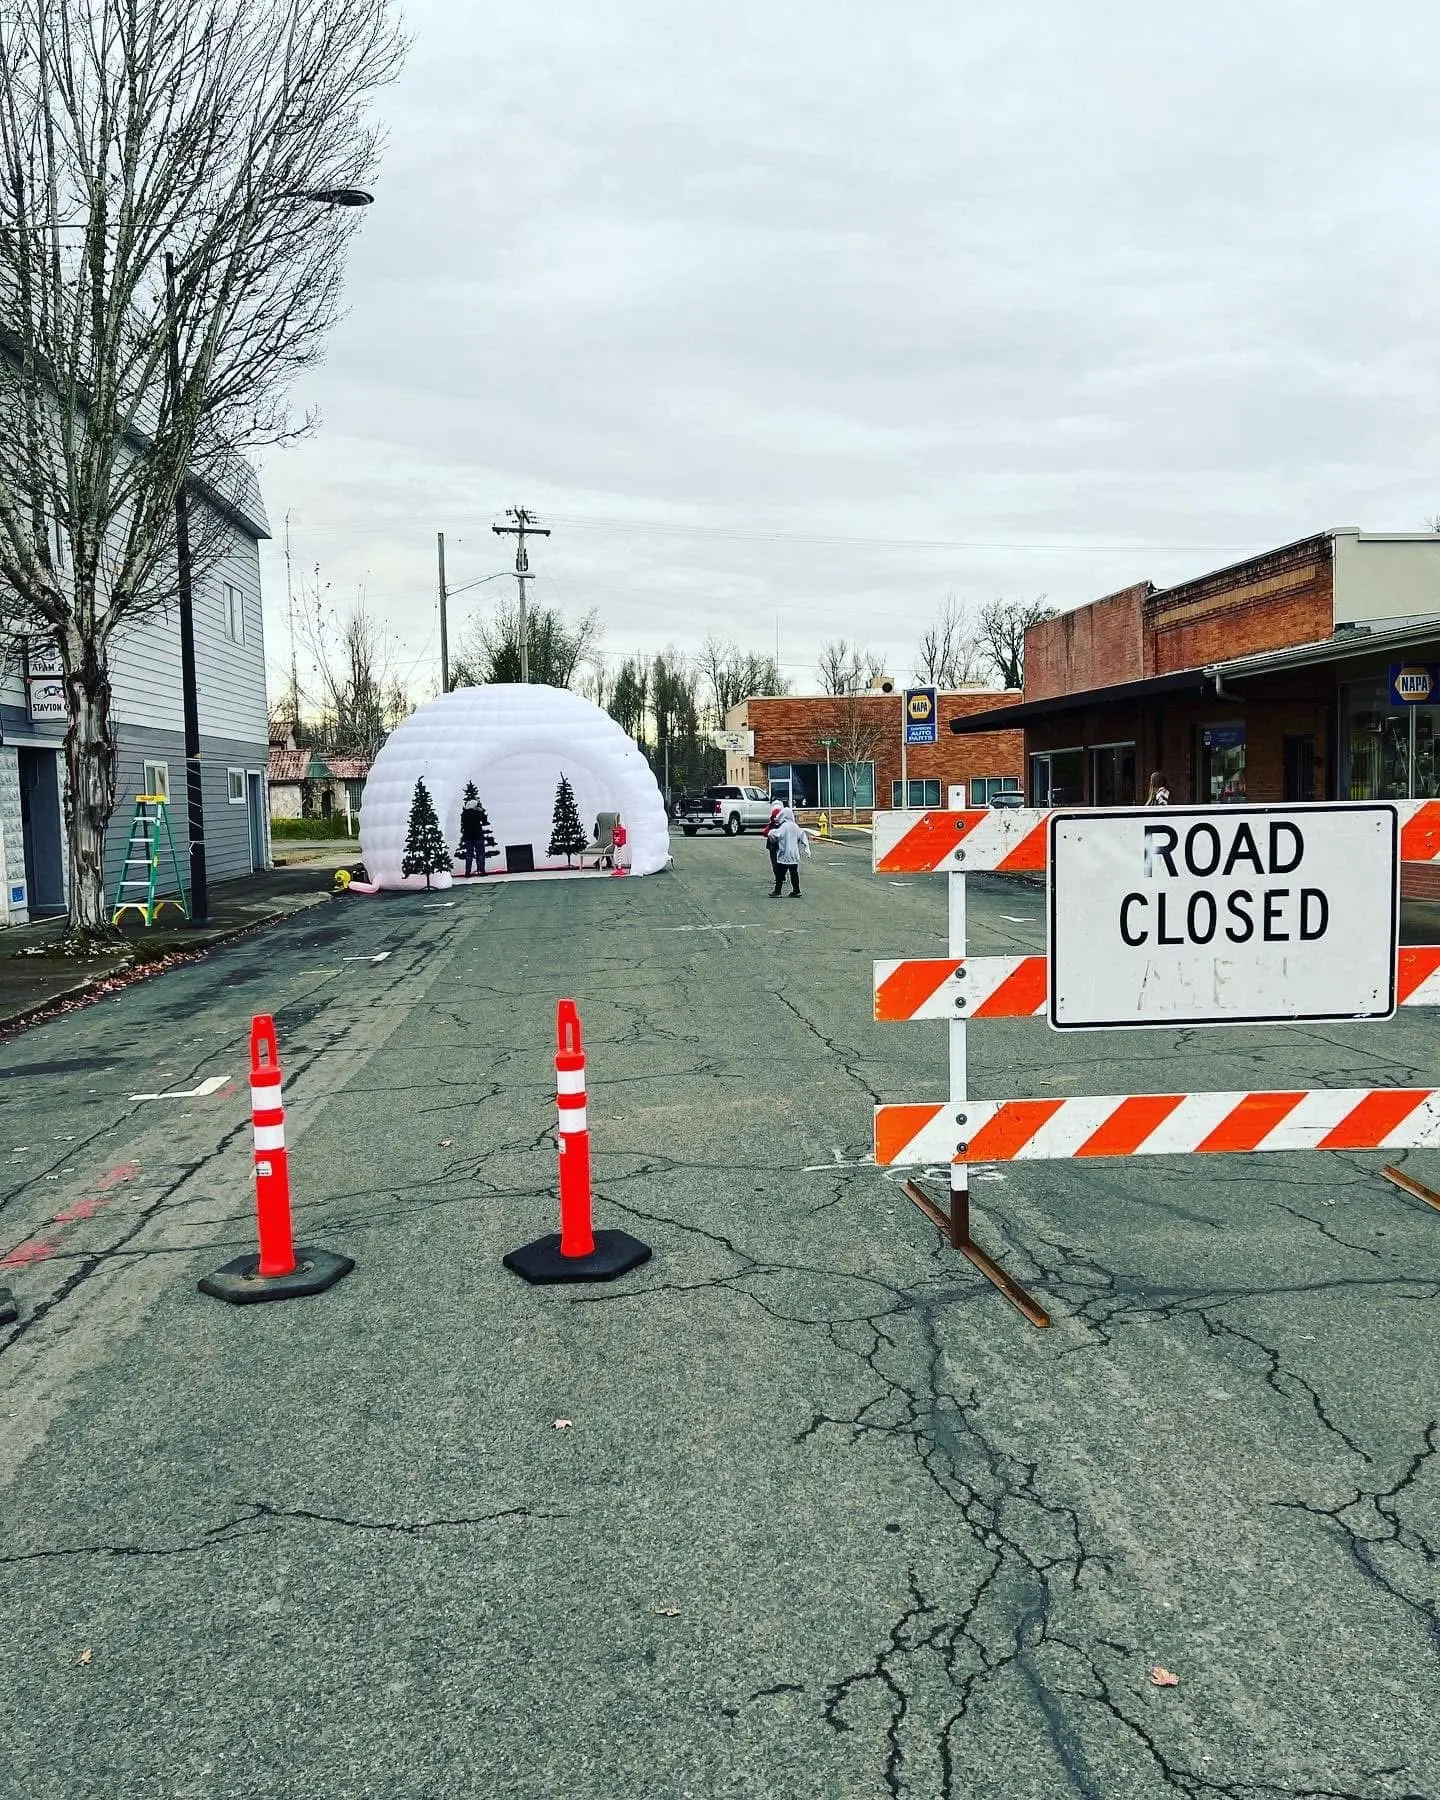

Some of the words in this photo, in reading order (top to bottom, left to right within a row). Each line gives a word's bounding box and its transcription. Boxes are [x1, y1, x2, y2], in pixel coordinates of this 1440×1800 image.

[1401, 676, 1428, 692] NAPA
[32, 703, 62, 712] STAYTON
[912, 702, 928, 712] NAPA
[1144, 821, 1305, 878] ROAD
[1119, 888, 1329, 947] CLOSED
